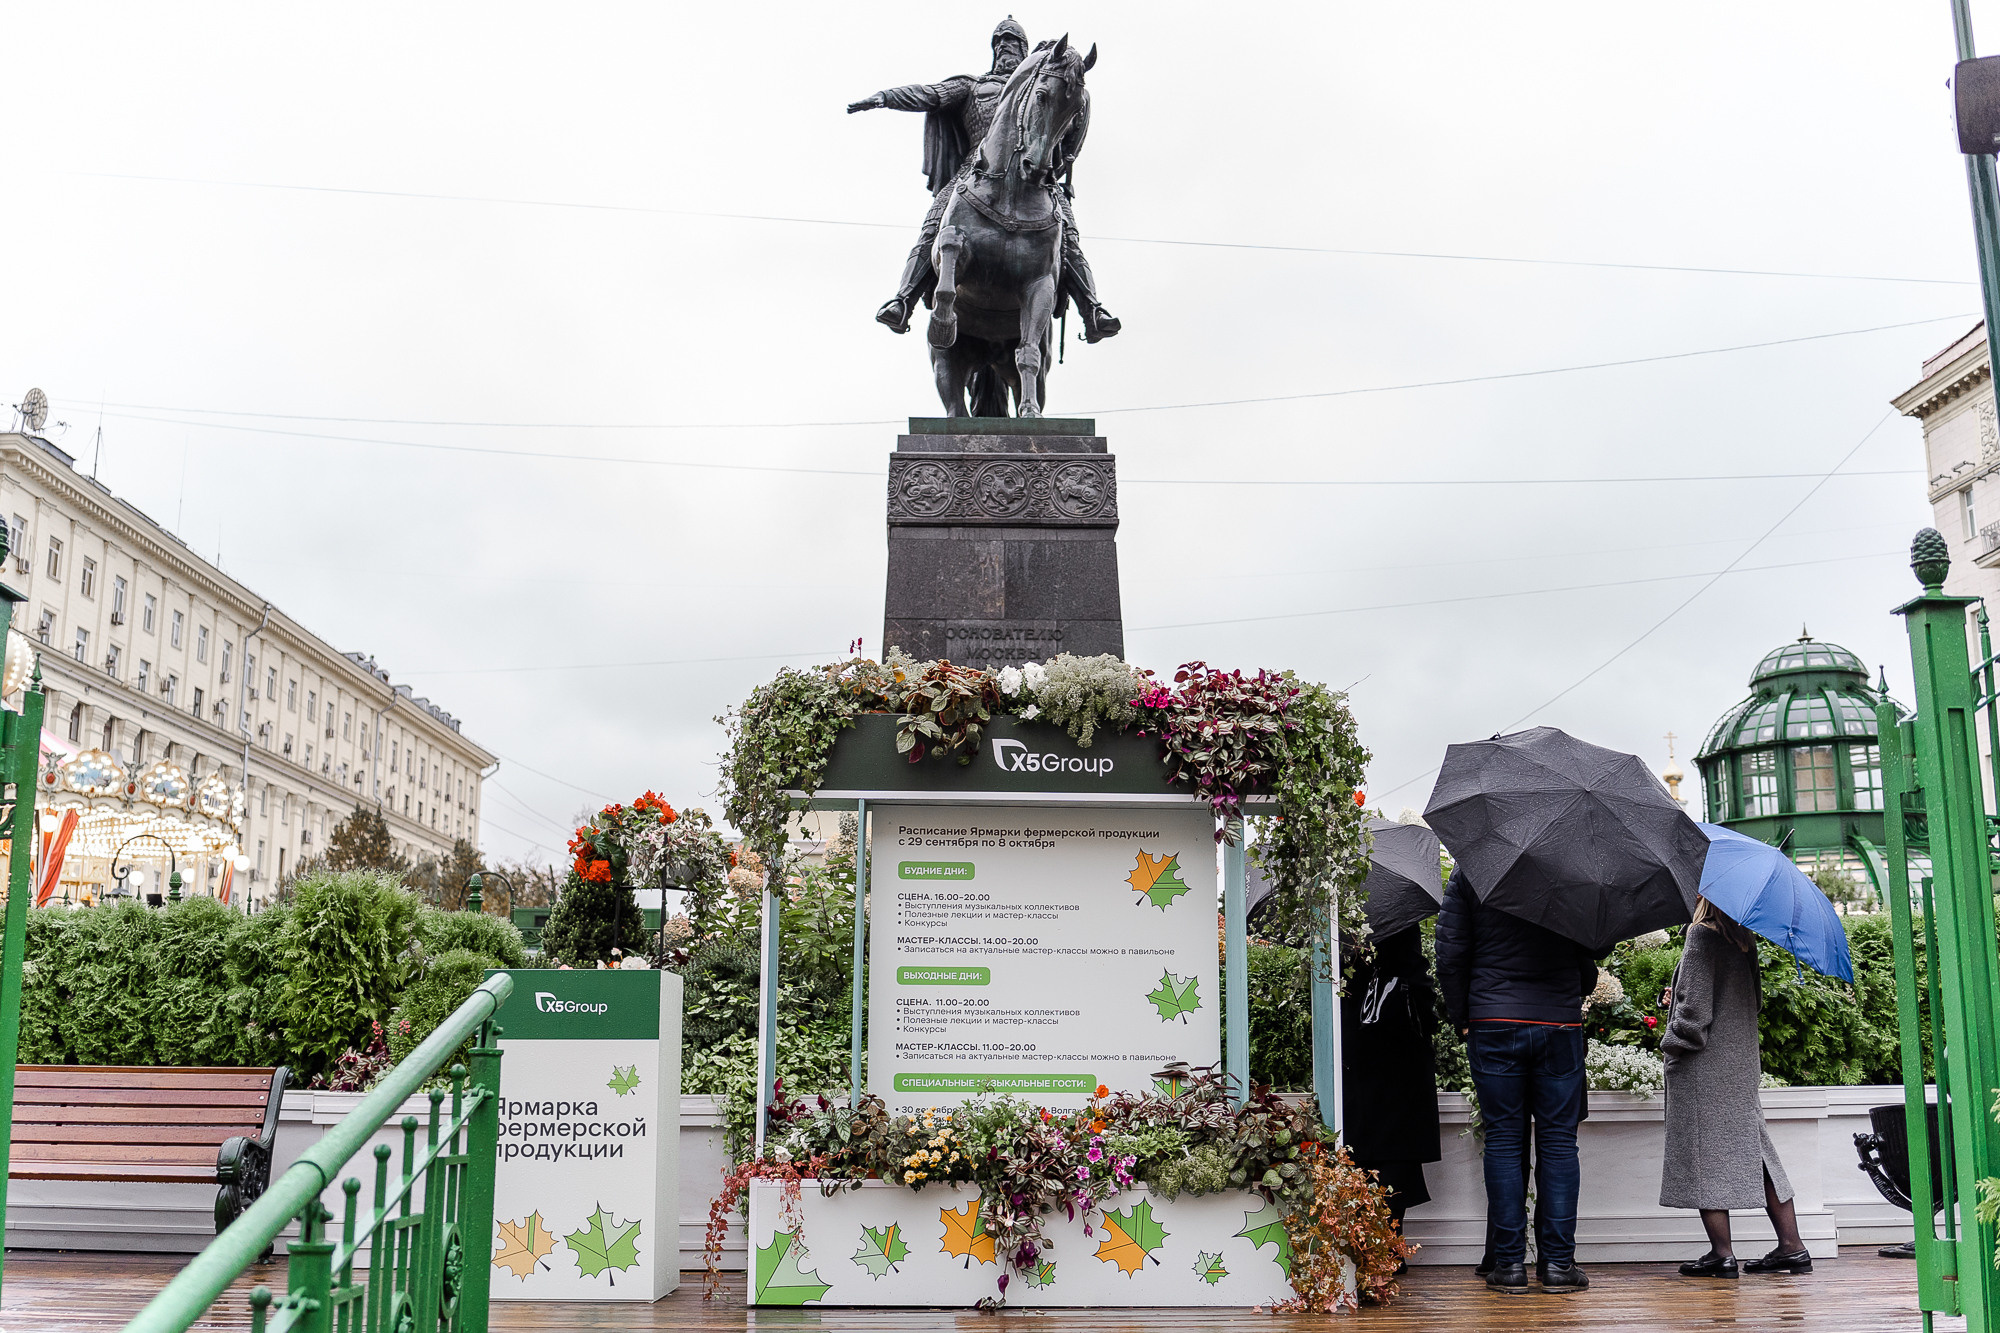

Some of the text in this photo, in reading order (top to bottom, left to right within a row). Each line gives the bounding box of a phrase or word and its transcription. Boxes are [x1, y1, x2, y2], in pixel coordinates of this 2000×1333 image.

[944, 627, 1065, 641] ОСНОВАТЕЛЮ
[966, 647, 1042, 660] МОСКВЫ
[1010, 753, 1114, 777] X5Group
[898, 825, 1160, 840] Расписание Ярмарки фермерской продукции
[898, 836, 1056, 849] с 29 сентября по 8 октября
[904, 866, 968, 877] БУДНИЕ ДНИ:
[897, 892, 933, 903] СЦЕНА.
[904, 902, 963, 911] Выступления
[964, 903, 1023, 912] музыкальных
[904, 911, 949, 919] Полезные
[950, 912, 983, 920] лекции
[992, 912, 1059, 921] мастер-классы
[904, 919, 948, 928] Конкурсы
[896, 936, 981, 945] МАСТЕР-КЛАССЫ.
[903, 945, 955, 954] Записаться
[968, 947, 1020, 956] актуальные
[1021, 947, 1088, 956] мастер-классы
[1128, 948, 1176, 956] павильоне
[903, 971, 983, 982] ВЫХОДНЫЕ ДНИ:
[545, 1000, 608, 1015] X5Group
[895, 998, 932, 1008] СЦЕНА.
[903, 1007, 962, 1017] Выступления
[964, 1009, 1023, 1018] музыкальных
[903, 1016, 949, 1025] Полезные
[949, 1017, 983, 1026] лекции
[992, 1018, 1059, 1027] мастер-классы
[903, 1025, 947, 1034] Конкурсы
[895, 1042, 981, 1052] МАСТЕР-КЛАССЫ.
[902, 1051, 954, 1060] Записаться
[968, 1053, 1020, 1062] актуальные
[1021, 1053, 1089, 1062] мастер-классы
[1129, 1054, 1177, 1062] павильоне
[901, 1078, 975, 1089] СПЕЦИАЛЬНЫЕ
[1052, 1079, 1087, 1088] ГОСТИ:
[901, 1105, 914, 1114] 30
